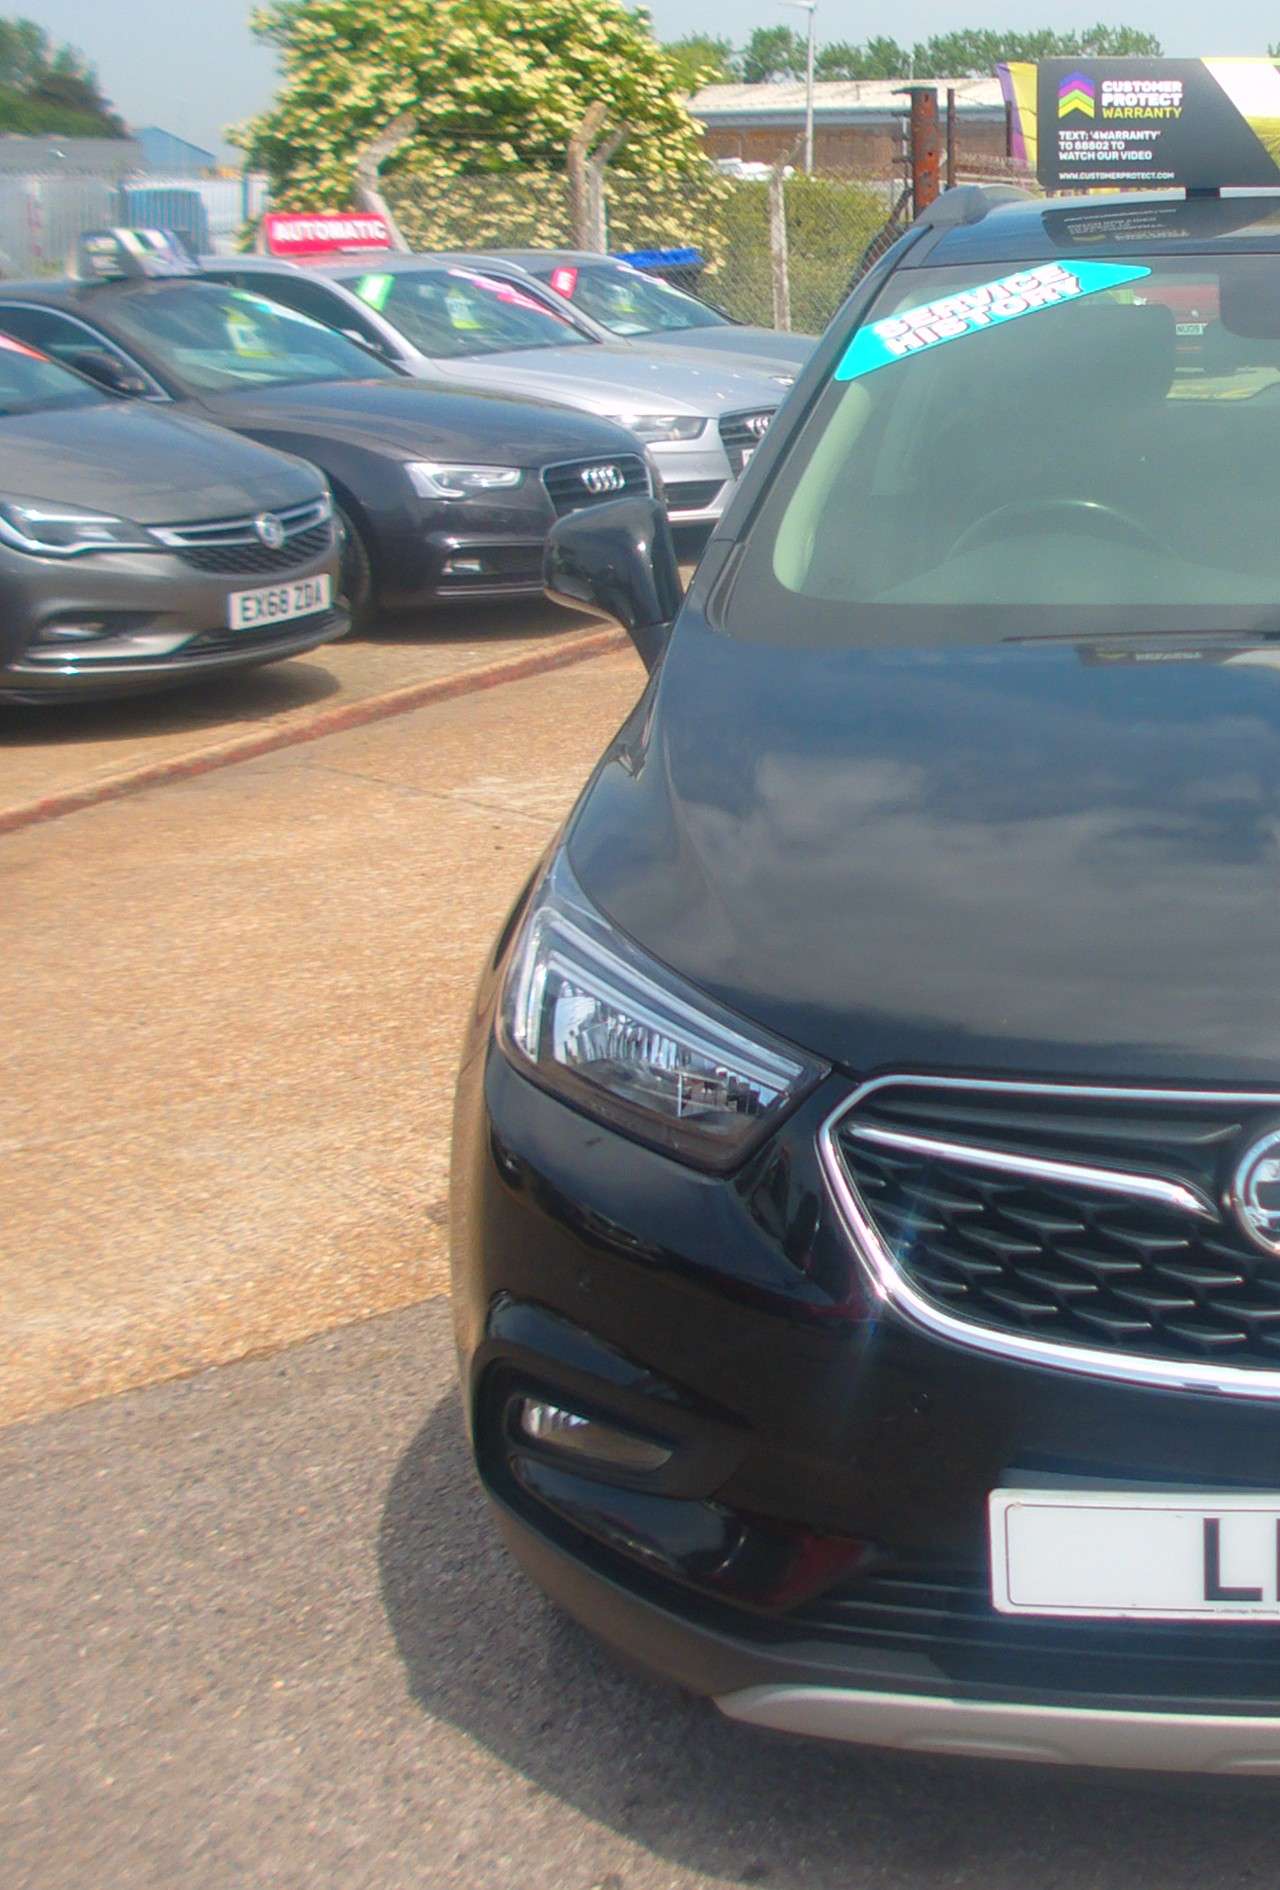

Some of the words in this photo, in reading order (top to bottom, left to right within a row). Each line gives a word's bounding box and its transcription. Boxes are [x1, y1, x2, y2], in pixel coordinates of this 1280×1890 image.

[1101, 80, 1183, 93] CUSTOMER
[1101, 93, 1183, 107] PROTECT
[1102, 107, 1182, 119] WARRANTY
[1058, 141, 1073, 151] TO
[1111, 141, 1126, 151] TO
[1058, 151, 1095, 161] WATCH
[1096, 151, 1119, 161] OUR
[1120, 151, 1153, 161] VIDEO
[272, 220, 388, 241] AUTOMATIC
[872, 261, 1073, 338] SERVICE
[885, 272, 1083, 356] HISTORY
